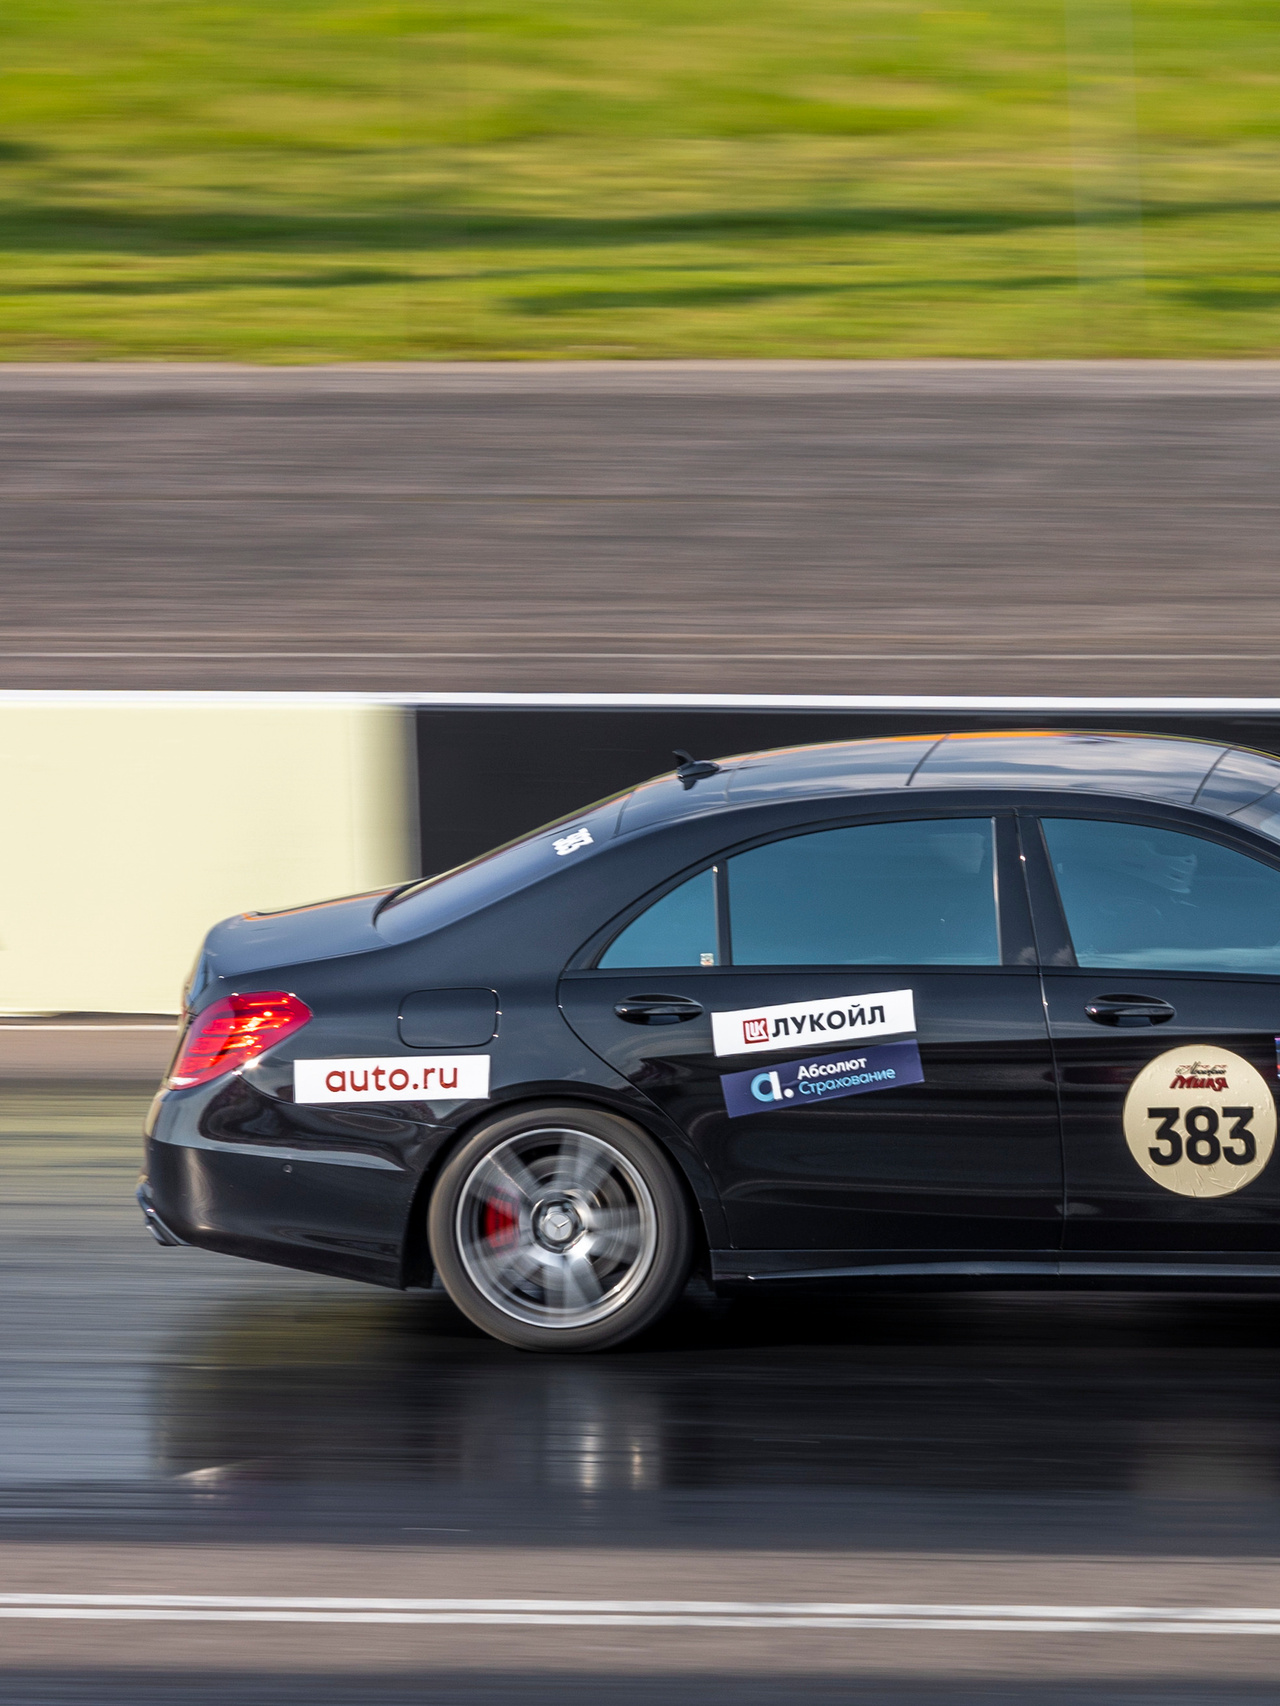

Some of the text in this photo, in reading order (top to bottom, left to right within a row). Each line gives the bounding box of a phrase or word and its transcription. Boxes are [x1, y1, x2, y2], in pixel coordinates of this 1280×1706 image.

[772, 1004, 886, 1038] ЛУКОЙЛ
[325, 1065, 458, 1092] auto.ru
[797, 1057, 867, 1080] Абсолют
[798, 1067, 897, 1096] Страхование
[1147, 1105, 1257, 1167] 383
